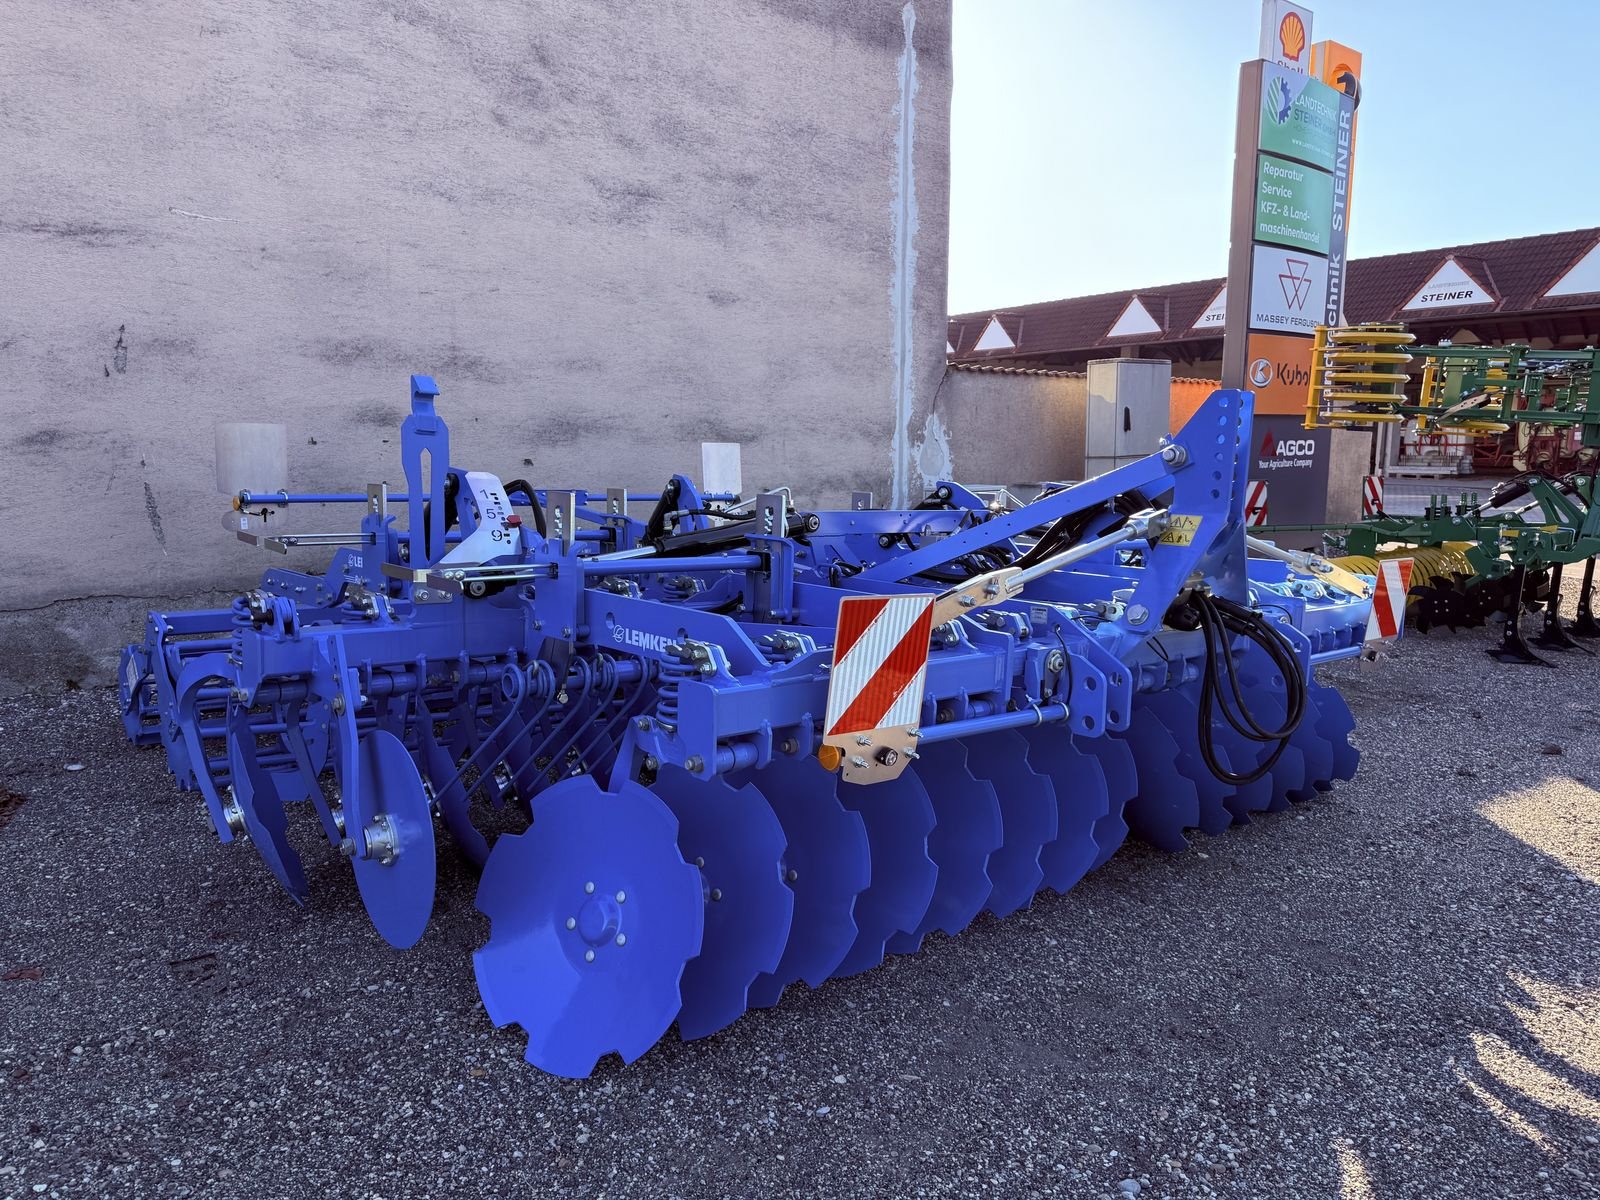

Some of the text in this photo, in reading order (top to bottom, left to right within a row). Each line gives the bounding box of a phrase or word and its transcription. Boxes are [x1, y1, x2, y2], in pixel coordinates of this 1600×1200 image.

[1263, 161, 1304, 182] Reparatur
[1332, 109, 1351, 232] STEINER
[1262, 181, 1293, 199] Service
[1260, 200, 1311, 221] KFZ- & Land-
[1259, 222, 1321, 244] maschinenhandel
[1420, 290, 1474, 303] STEINER
[1256, 313, 1290, 325] MASSEY
[1276, 362, 1312, 387] Kubo
[1276, 439, 1315, 457] AGCO
[1258, 458, 1313, 471] Your Agriculture Company
[486, 508, 497, 520] 5
[491, 529, 503, 542] 9
